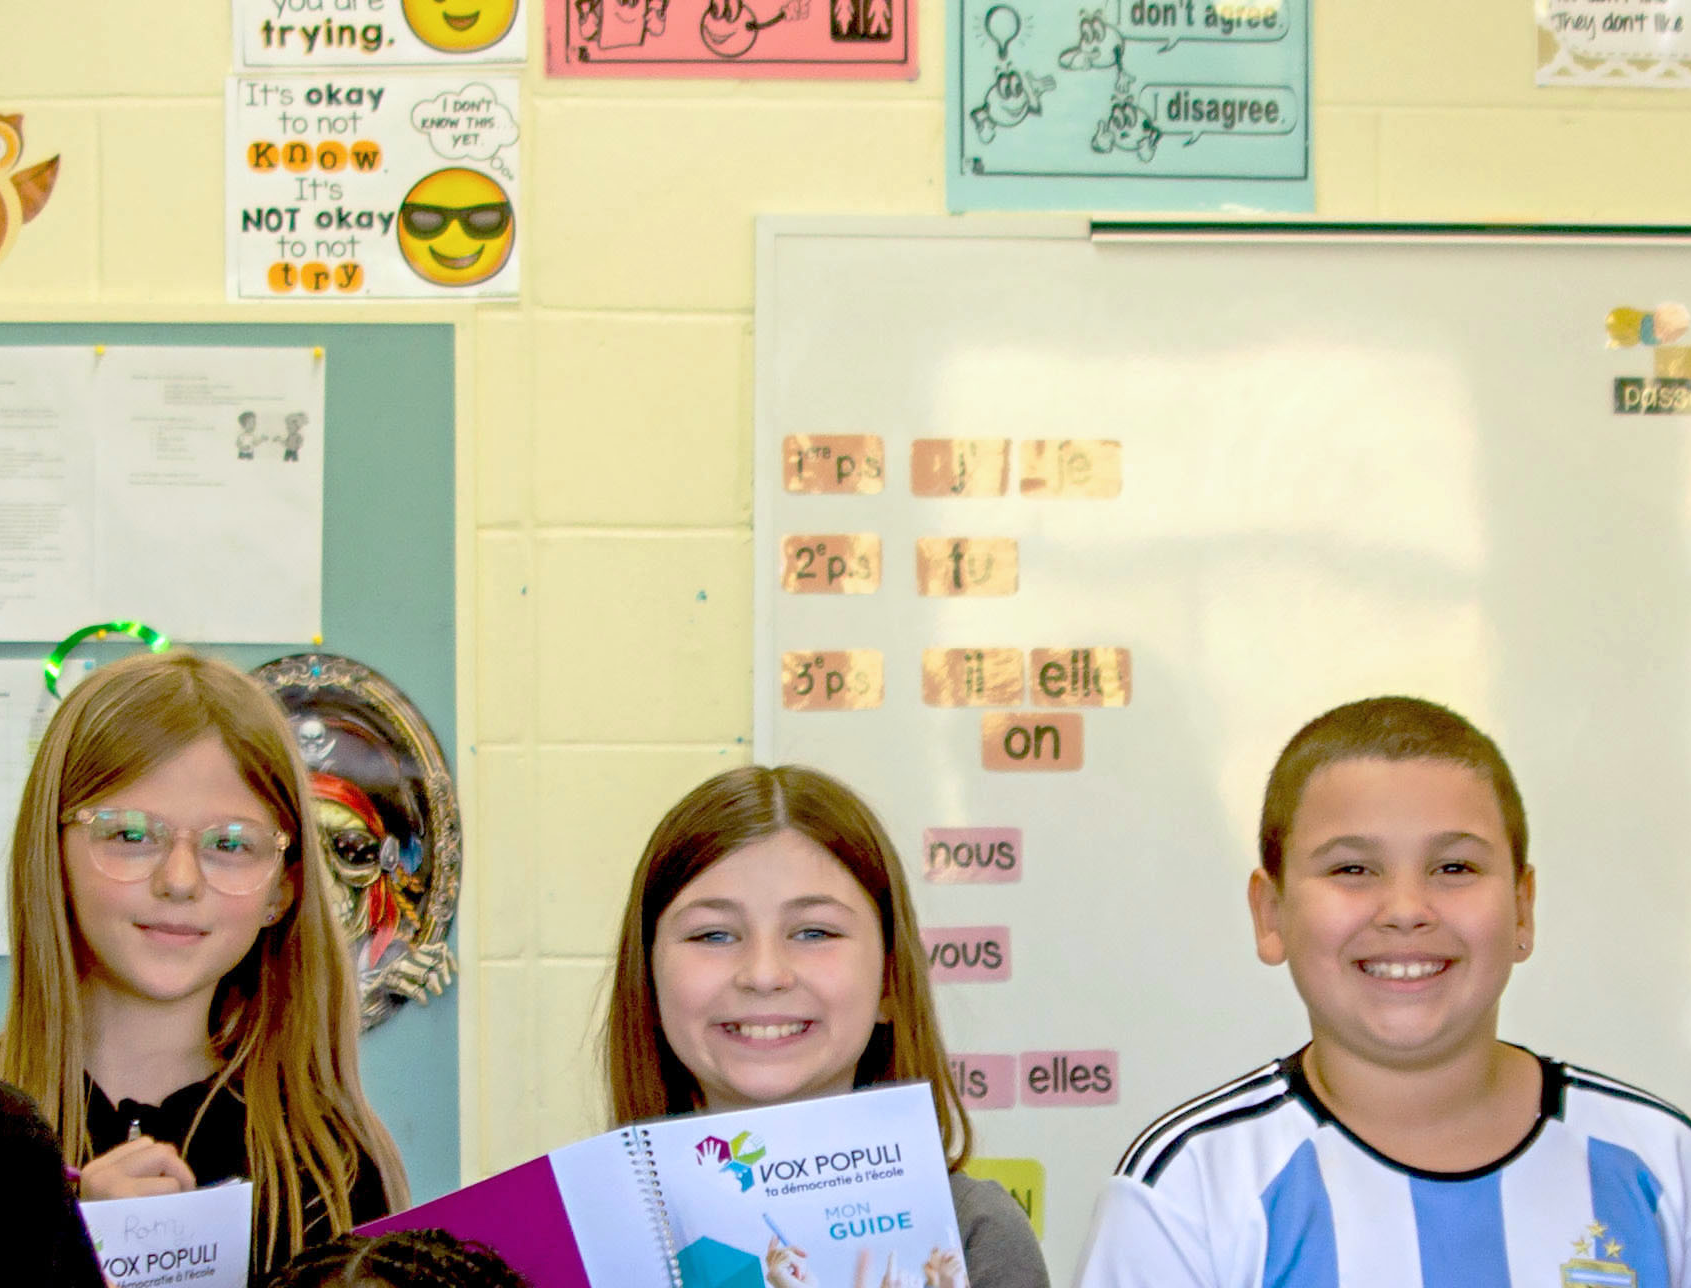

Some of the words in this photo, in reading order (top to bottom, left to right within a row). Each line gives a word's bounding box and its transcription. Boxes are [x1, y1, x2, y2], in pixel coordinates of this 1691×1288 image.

[1130, 0, 1196, 28] don't
[1551, 13, 1597, 41] They
[1602, 12, 1648, 32] don't
[1654, 13, 1685, 33] like
[262, 18, 395, 55] trying.
[246, 83, 294, 107] It's
[305, 83, 385, 111] okay
[278, 112, 308, 135] to
[317, 112, 362, 134] not
[421, 116, 459, 130] KNOW
[294, 178, 343, 201] It's
[242, 208, 300, 233] NOT
[314, 207, 395, 237] okay
[278, 235, 307, 258] to
[316, 235, 361, 258] not
[1003, 725, 1061, 761] on
[929, 840, 1017, 870] nous
[1028, 1055, 1113, 1094] elles
[760, 1158, 810, 1184] VOX
[815, 1143, 902, 1175] POPULI
[765, 1187, 780, 1198] ta
[781, 1175, 853, 1196] démocratie
[855, 1172, 864, 1184] à
[865, 1166, 906, 1182] l'école
[825, 1202, 871, 1221] MON
[829, 1210, 914, 1241] GUIDE
[147, 1241, 218, 1273] POPULI
